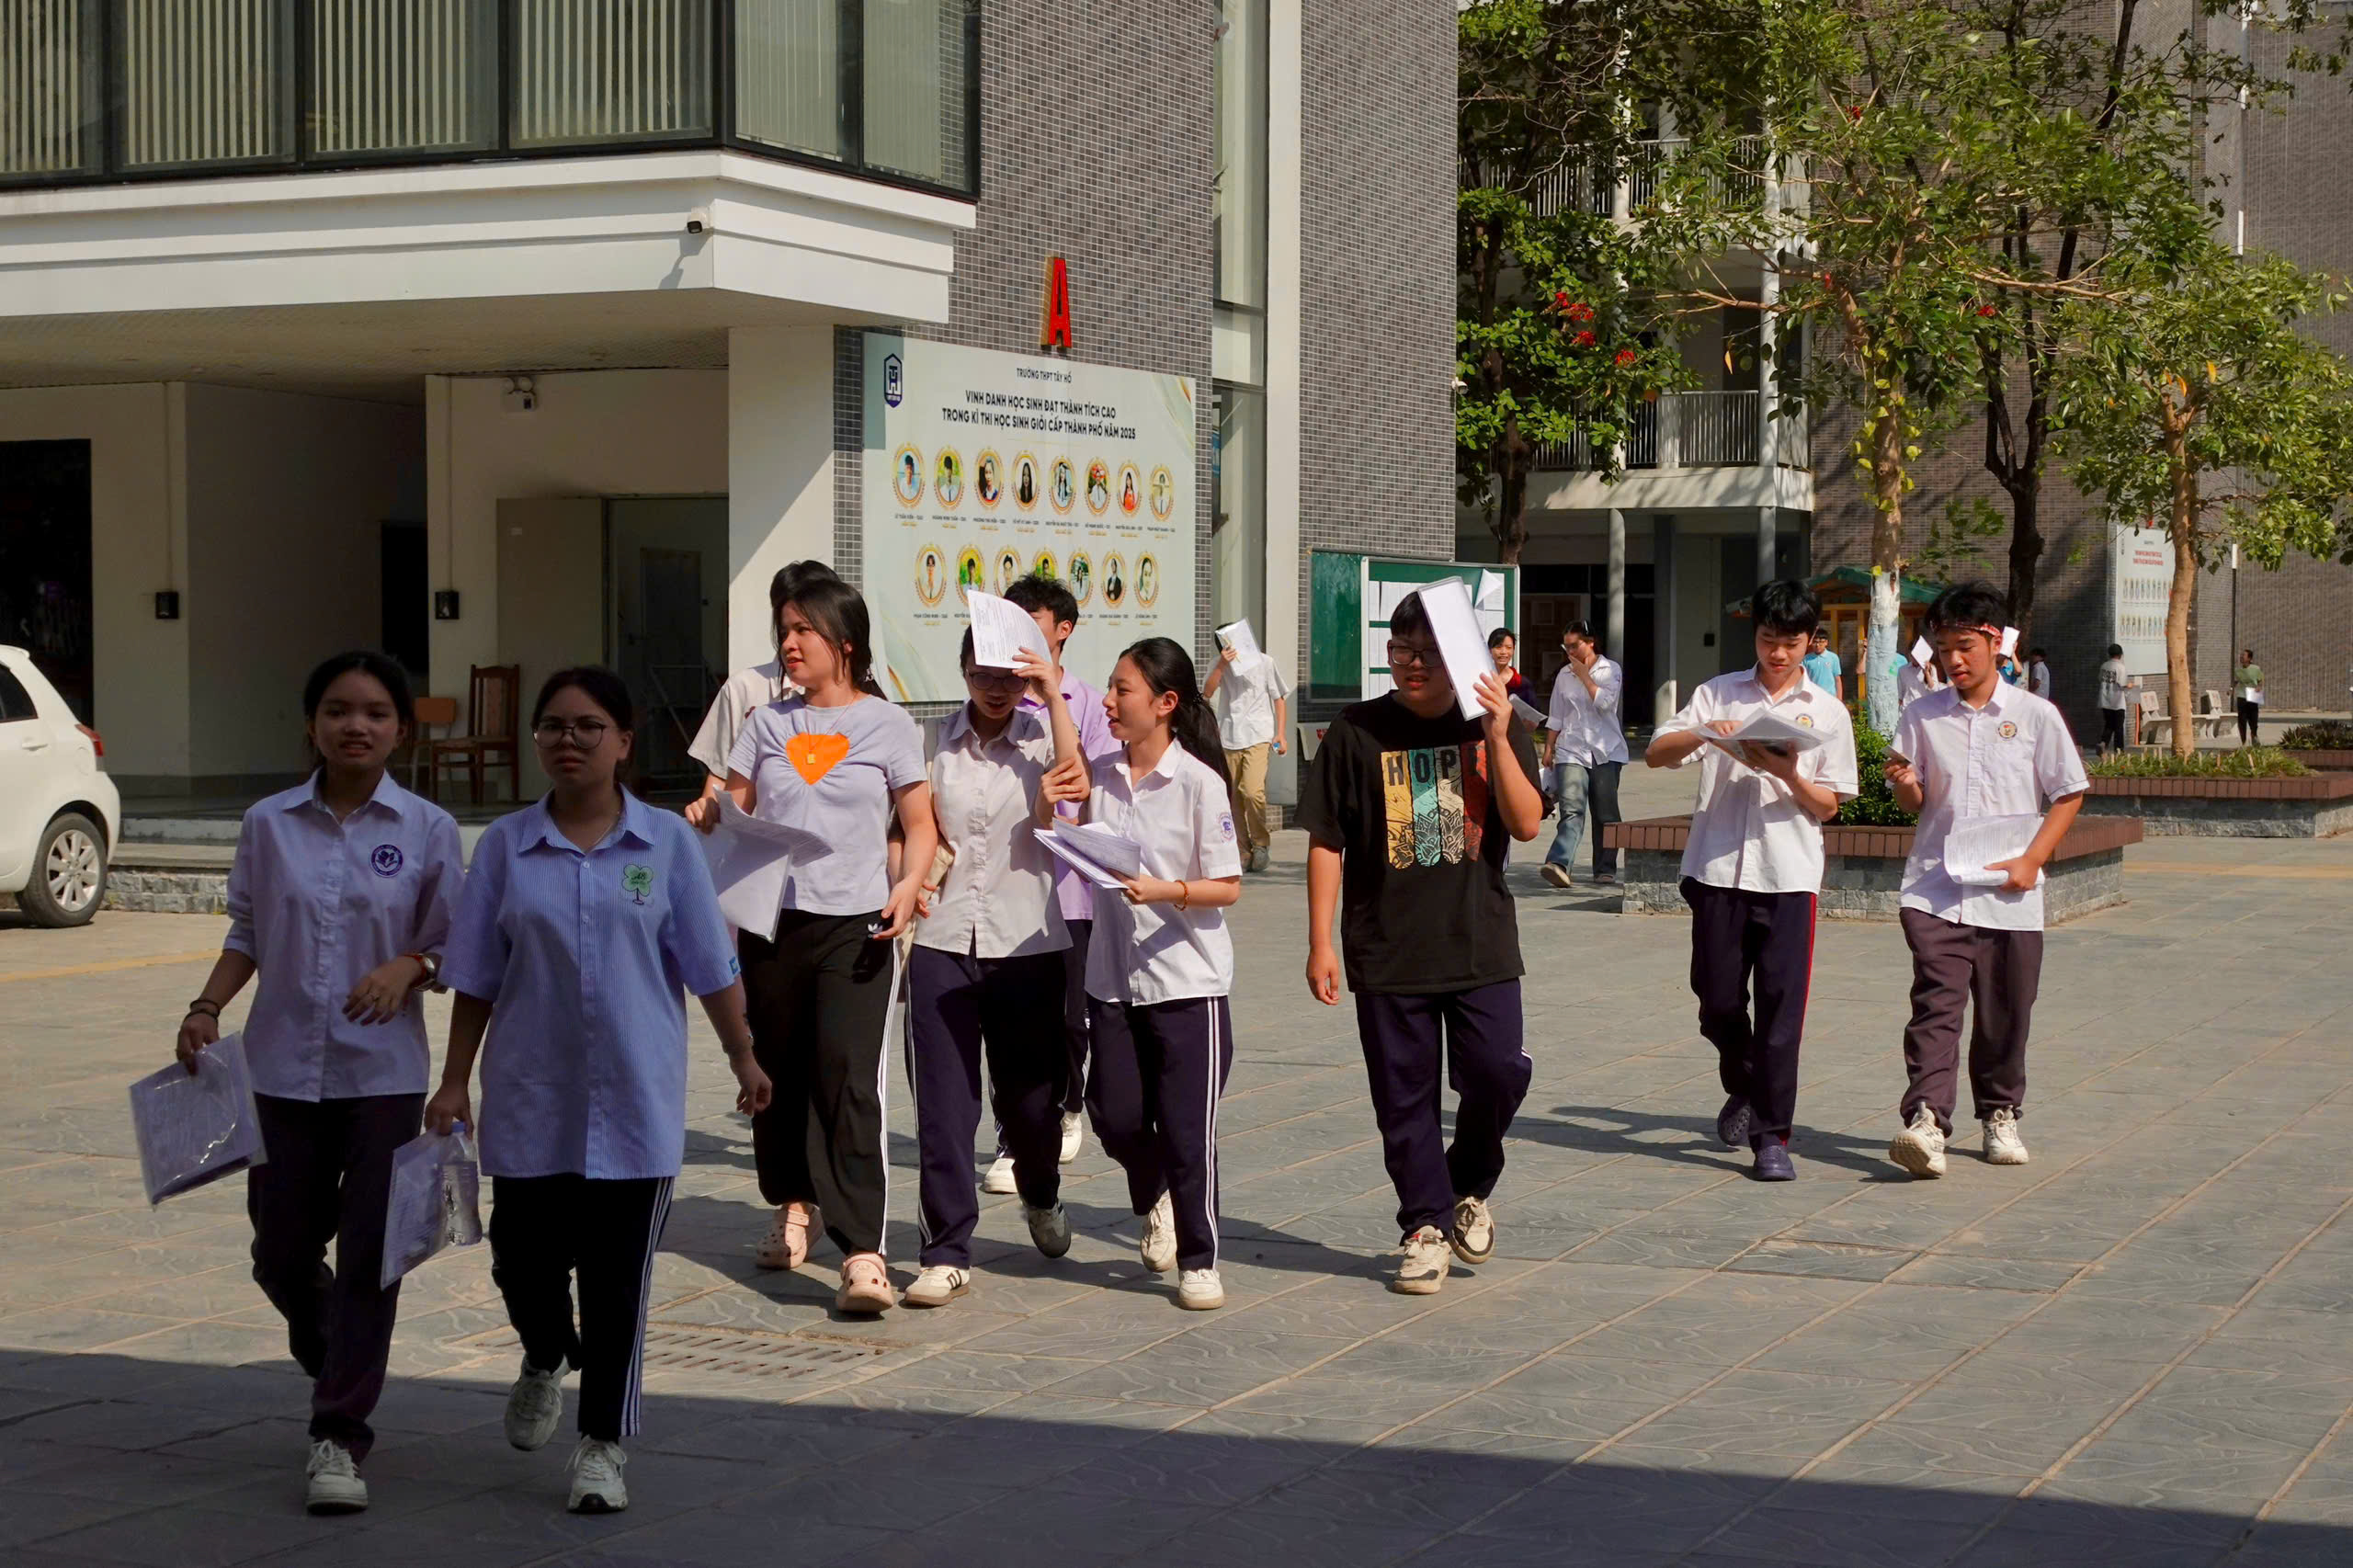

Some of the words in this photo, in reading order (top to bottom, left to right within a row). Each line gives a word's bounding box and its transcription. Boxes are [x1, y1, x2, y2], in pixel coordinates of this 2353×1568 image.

[1048, 256, 1073, 348] A
[1040, 370, 1052, 381] THPT
[1054, 370, 1063, 382] TÂY
[965, 390, 984, 404] VINH
[985, 392, 1006, 407] DANH
[1007, 396, 1024, 411] HỌC
[1026, 398, 1043, 412] SINH
[1044, 401, 1058, 415] ĐẠT
[1060, 400, 1083, 416] THÀNH
[1085, 402, 1099, 417] TÍCH
[1100, 406, 1117, 419] CAO
[942, 407, 970, 423] TRONG
[971, 408, 979, 424] KÌ
[981, 412, 993, 426] THI
[994, 415, 1010, 430] HỌC
[1012, 415, 1029, 429] SINH
[1030, 415, 1047, 431] GIỎI
[1048, 416, 1063, 432] CẤP
[1064, 420, 1087, 435] THÀNH
[1088, 420, 1103, 437] PHỐ
[1104, 425, 1120, 438] NĂM
[1120, 427, 1136, 439] 2025
